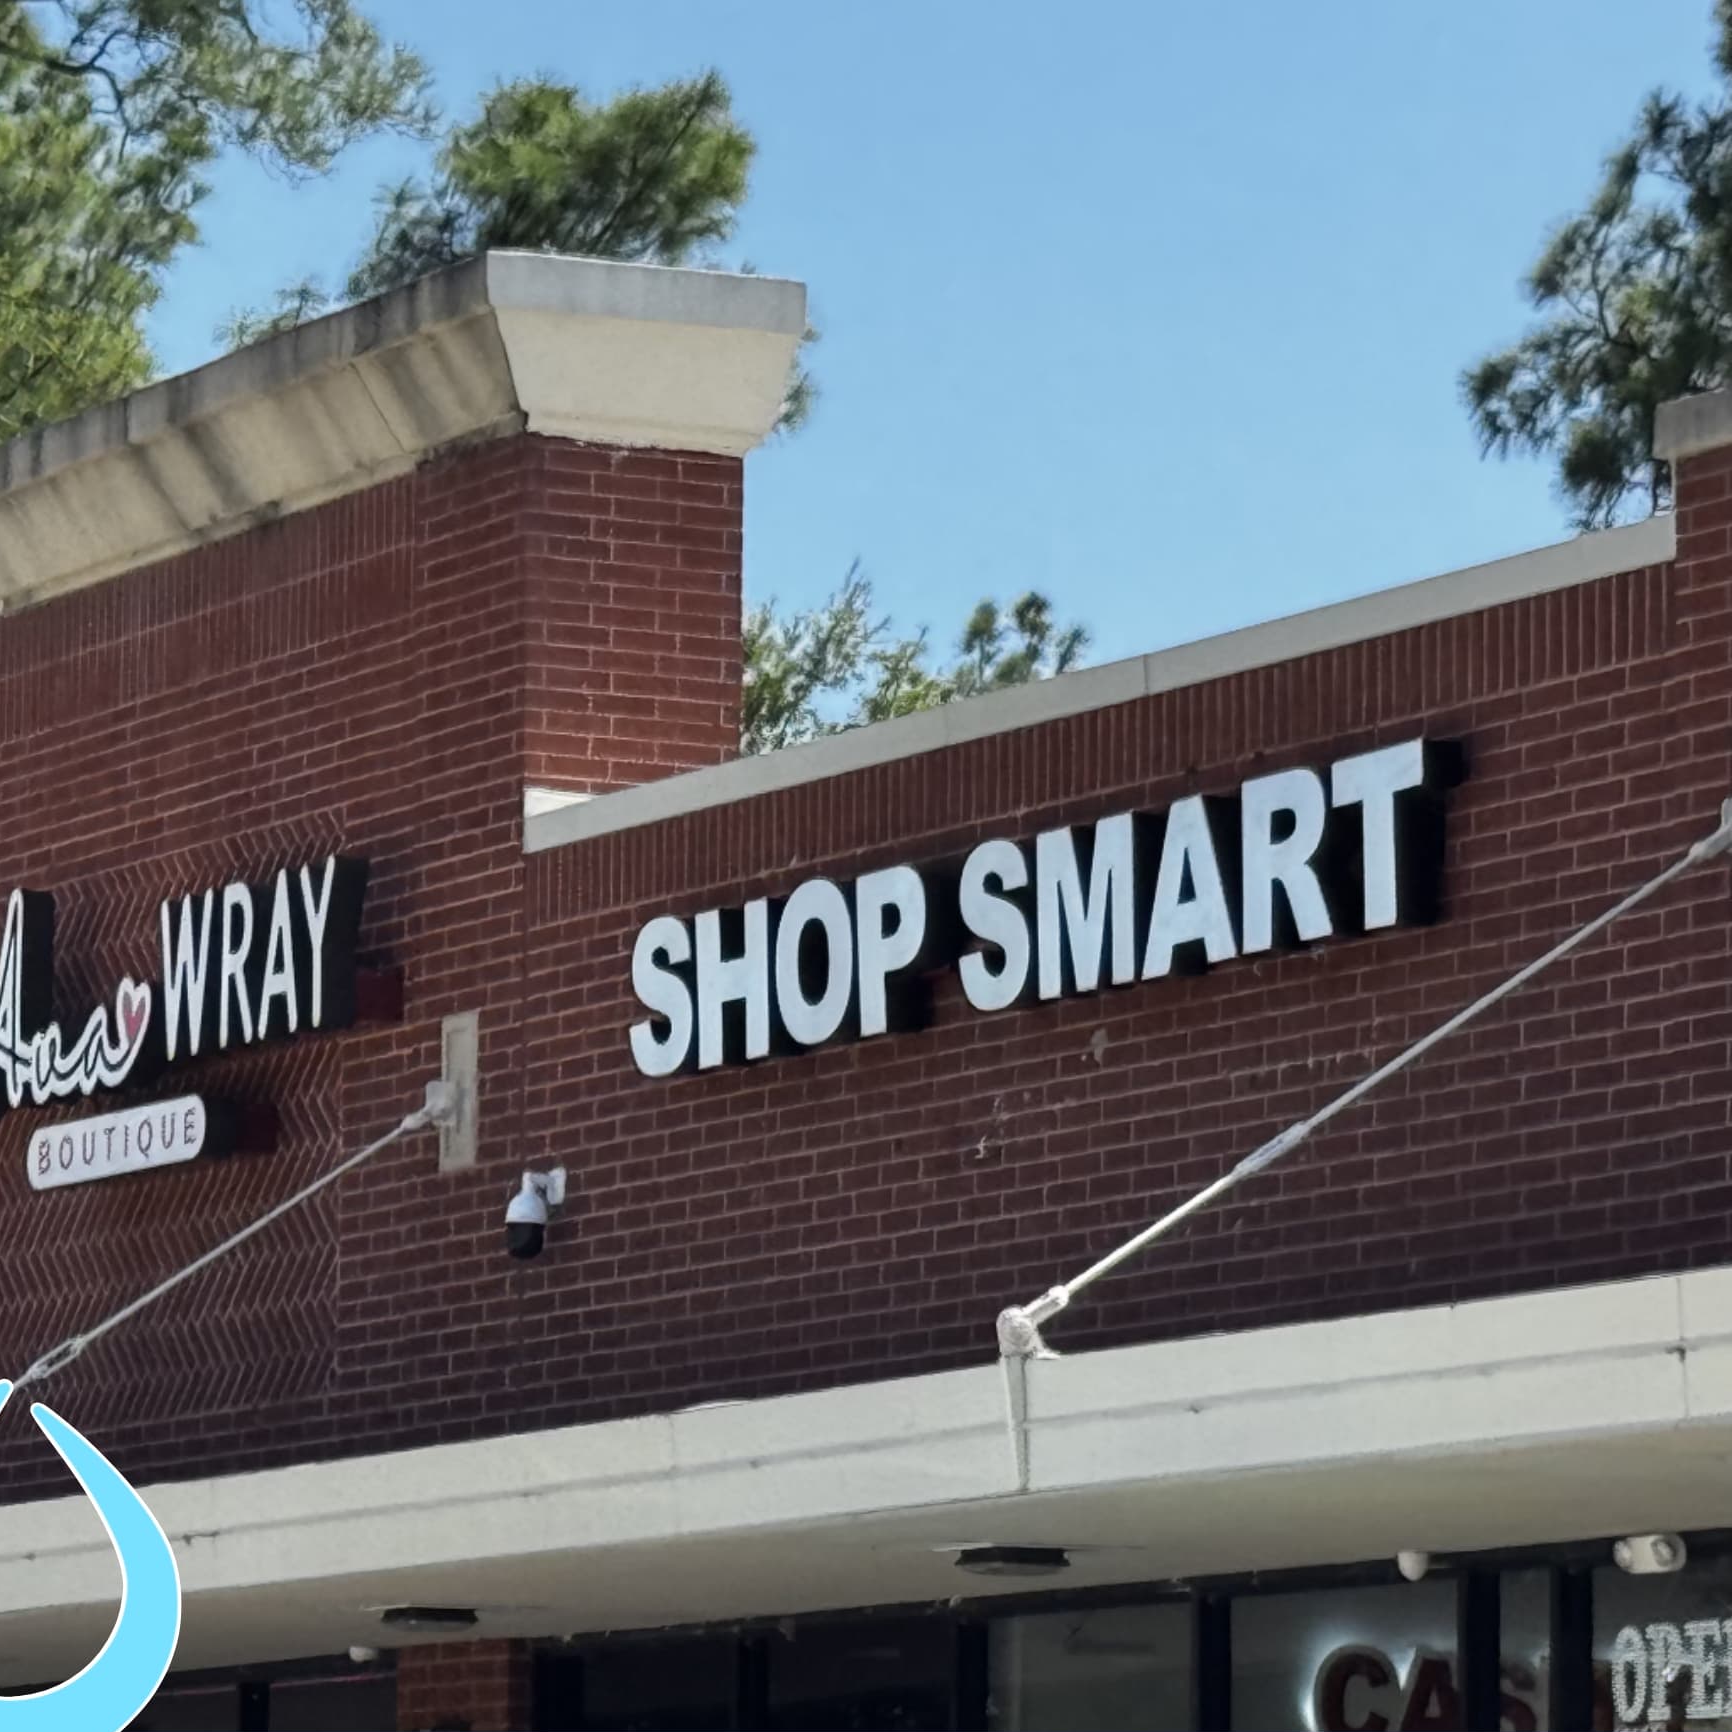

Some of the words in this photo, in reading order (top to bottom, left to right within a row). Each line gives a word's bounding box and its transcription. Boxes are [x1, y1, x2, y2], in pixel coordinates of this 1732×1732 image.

[161, 854, 335, 1061] WRAY
[629, 861, 927, 1078] SHOP
[957, 738, 1424, 1011] SMART
[38, 1106, 197, 1176] BOUTIQUE
[1611, 1619, 1732, 1723] OPE
